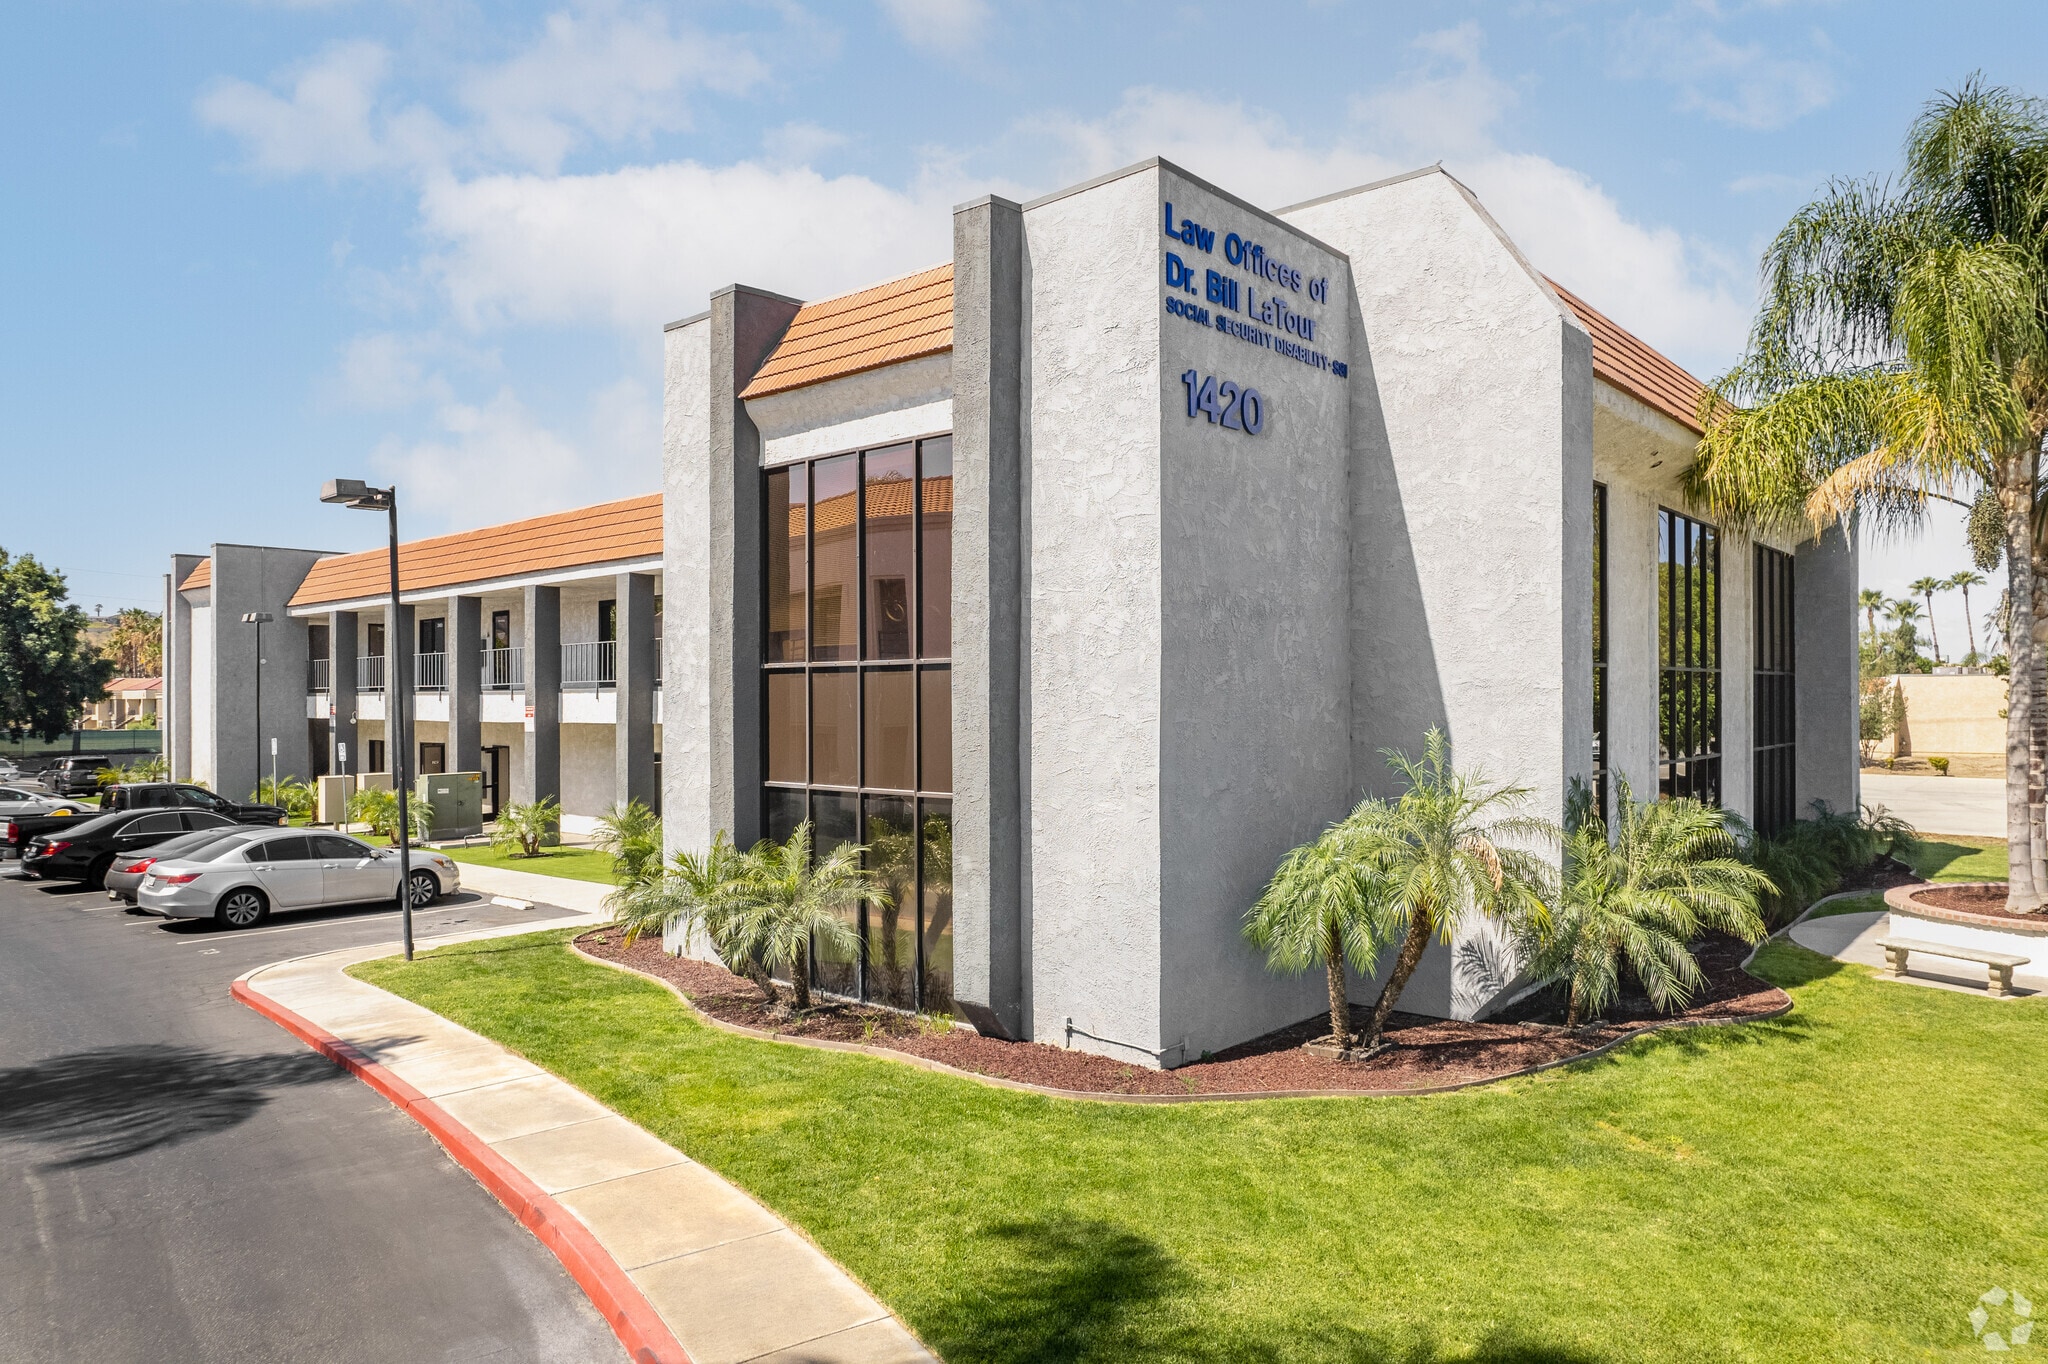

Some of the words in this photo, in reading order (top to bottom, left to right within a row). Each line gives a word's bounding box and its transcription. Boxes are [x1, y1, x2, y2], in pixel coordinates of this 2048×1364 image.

[1165, 201, 1215, 254] Law
[1225, 232, 1301, 293] Offices
[1309, 277, 1329, 305] of
[1166, 251, 1197, 295] Dr.
[1206, 268, 1241, 313] Bill
[1248, 286, 1316, 342] LaTour
[1166, 296, 1213, 328] SOCIAL
[1216, 314, 1272, 350] SECURITY
[1182, 369, 1264, 435] 1420
